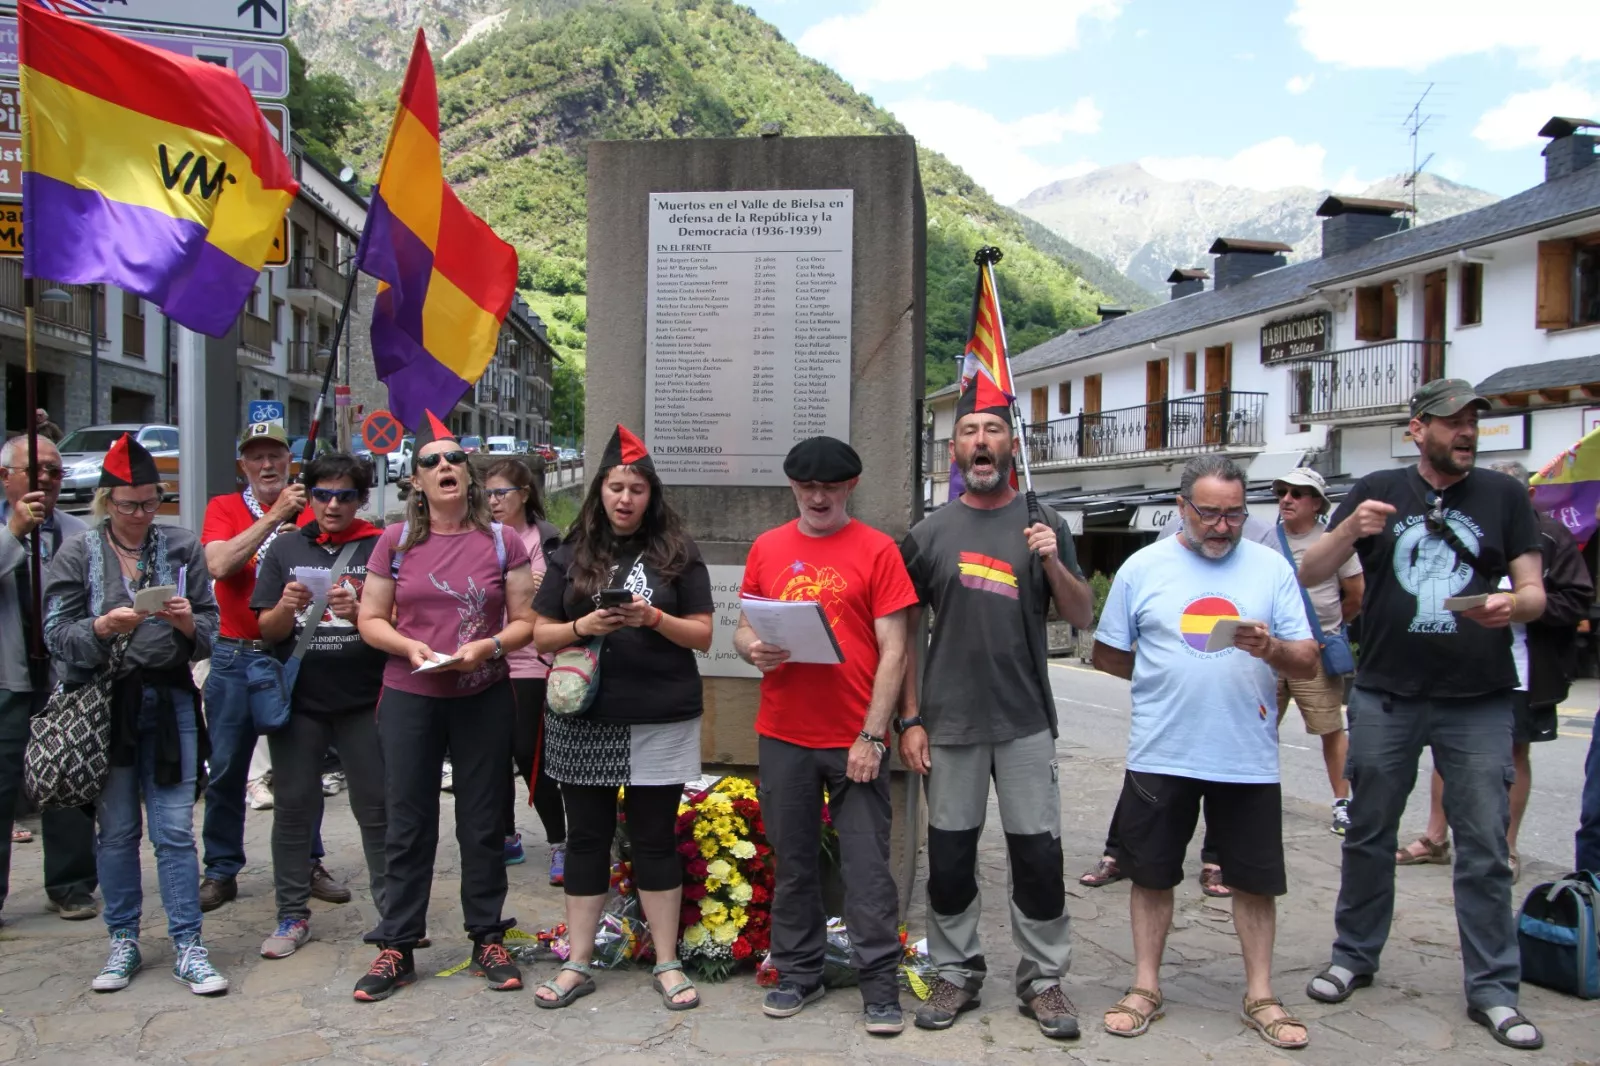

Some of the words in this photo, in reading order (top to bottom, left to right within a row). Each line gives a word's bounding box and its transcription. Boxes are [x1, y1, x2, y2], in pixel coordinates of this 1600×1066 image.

[658, 200, 706, 211] Muertos
[709, 202, 723, 210] en
[727, 199, 737, 210] el
[741, 199, 768, 210] Valle
[772, 198, 787, 209] de
[791, 198, 826, 209] Bielsa
[829, 200, 844, 208] en
[669, 212, 713, 224] defensa
[717, 212, 732, 223] de
[735, 212, 746, 223] la
[750, 210, 808, 225] República
[812, 214, 819, 224] y
[822, 211, 832, 222] la
[678, 225, 748, 237] Democracia
[751, 224, 822, 237] (1936-1939)
[657, 244, 668, 252] EN
[670, 244, 679, 252] EL
[682, 243, 712, 251] FRENTE
[1262, 316, 1325, 347] HABITACIONES
[1270, 348, 1284, 359] Los
[667, 446, 722, 454] BOMBARDEO
[1152, 510, 1177, 526] Caf
